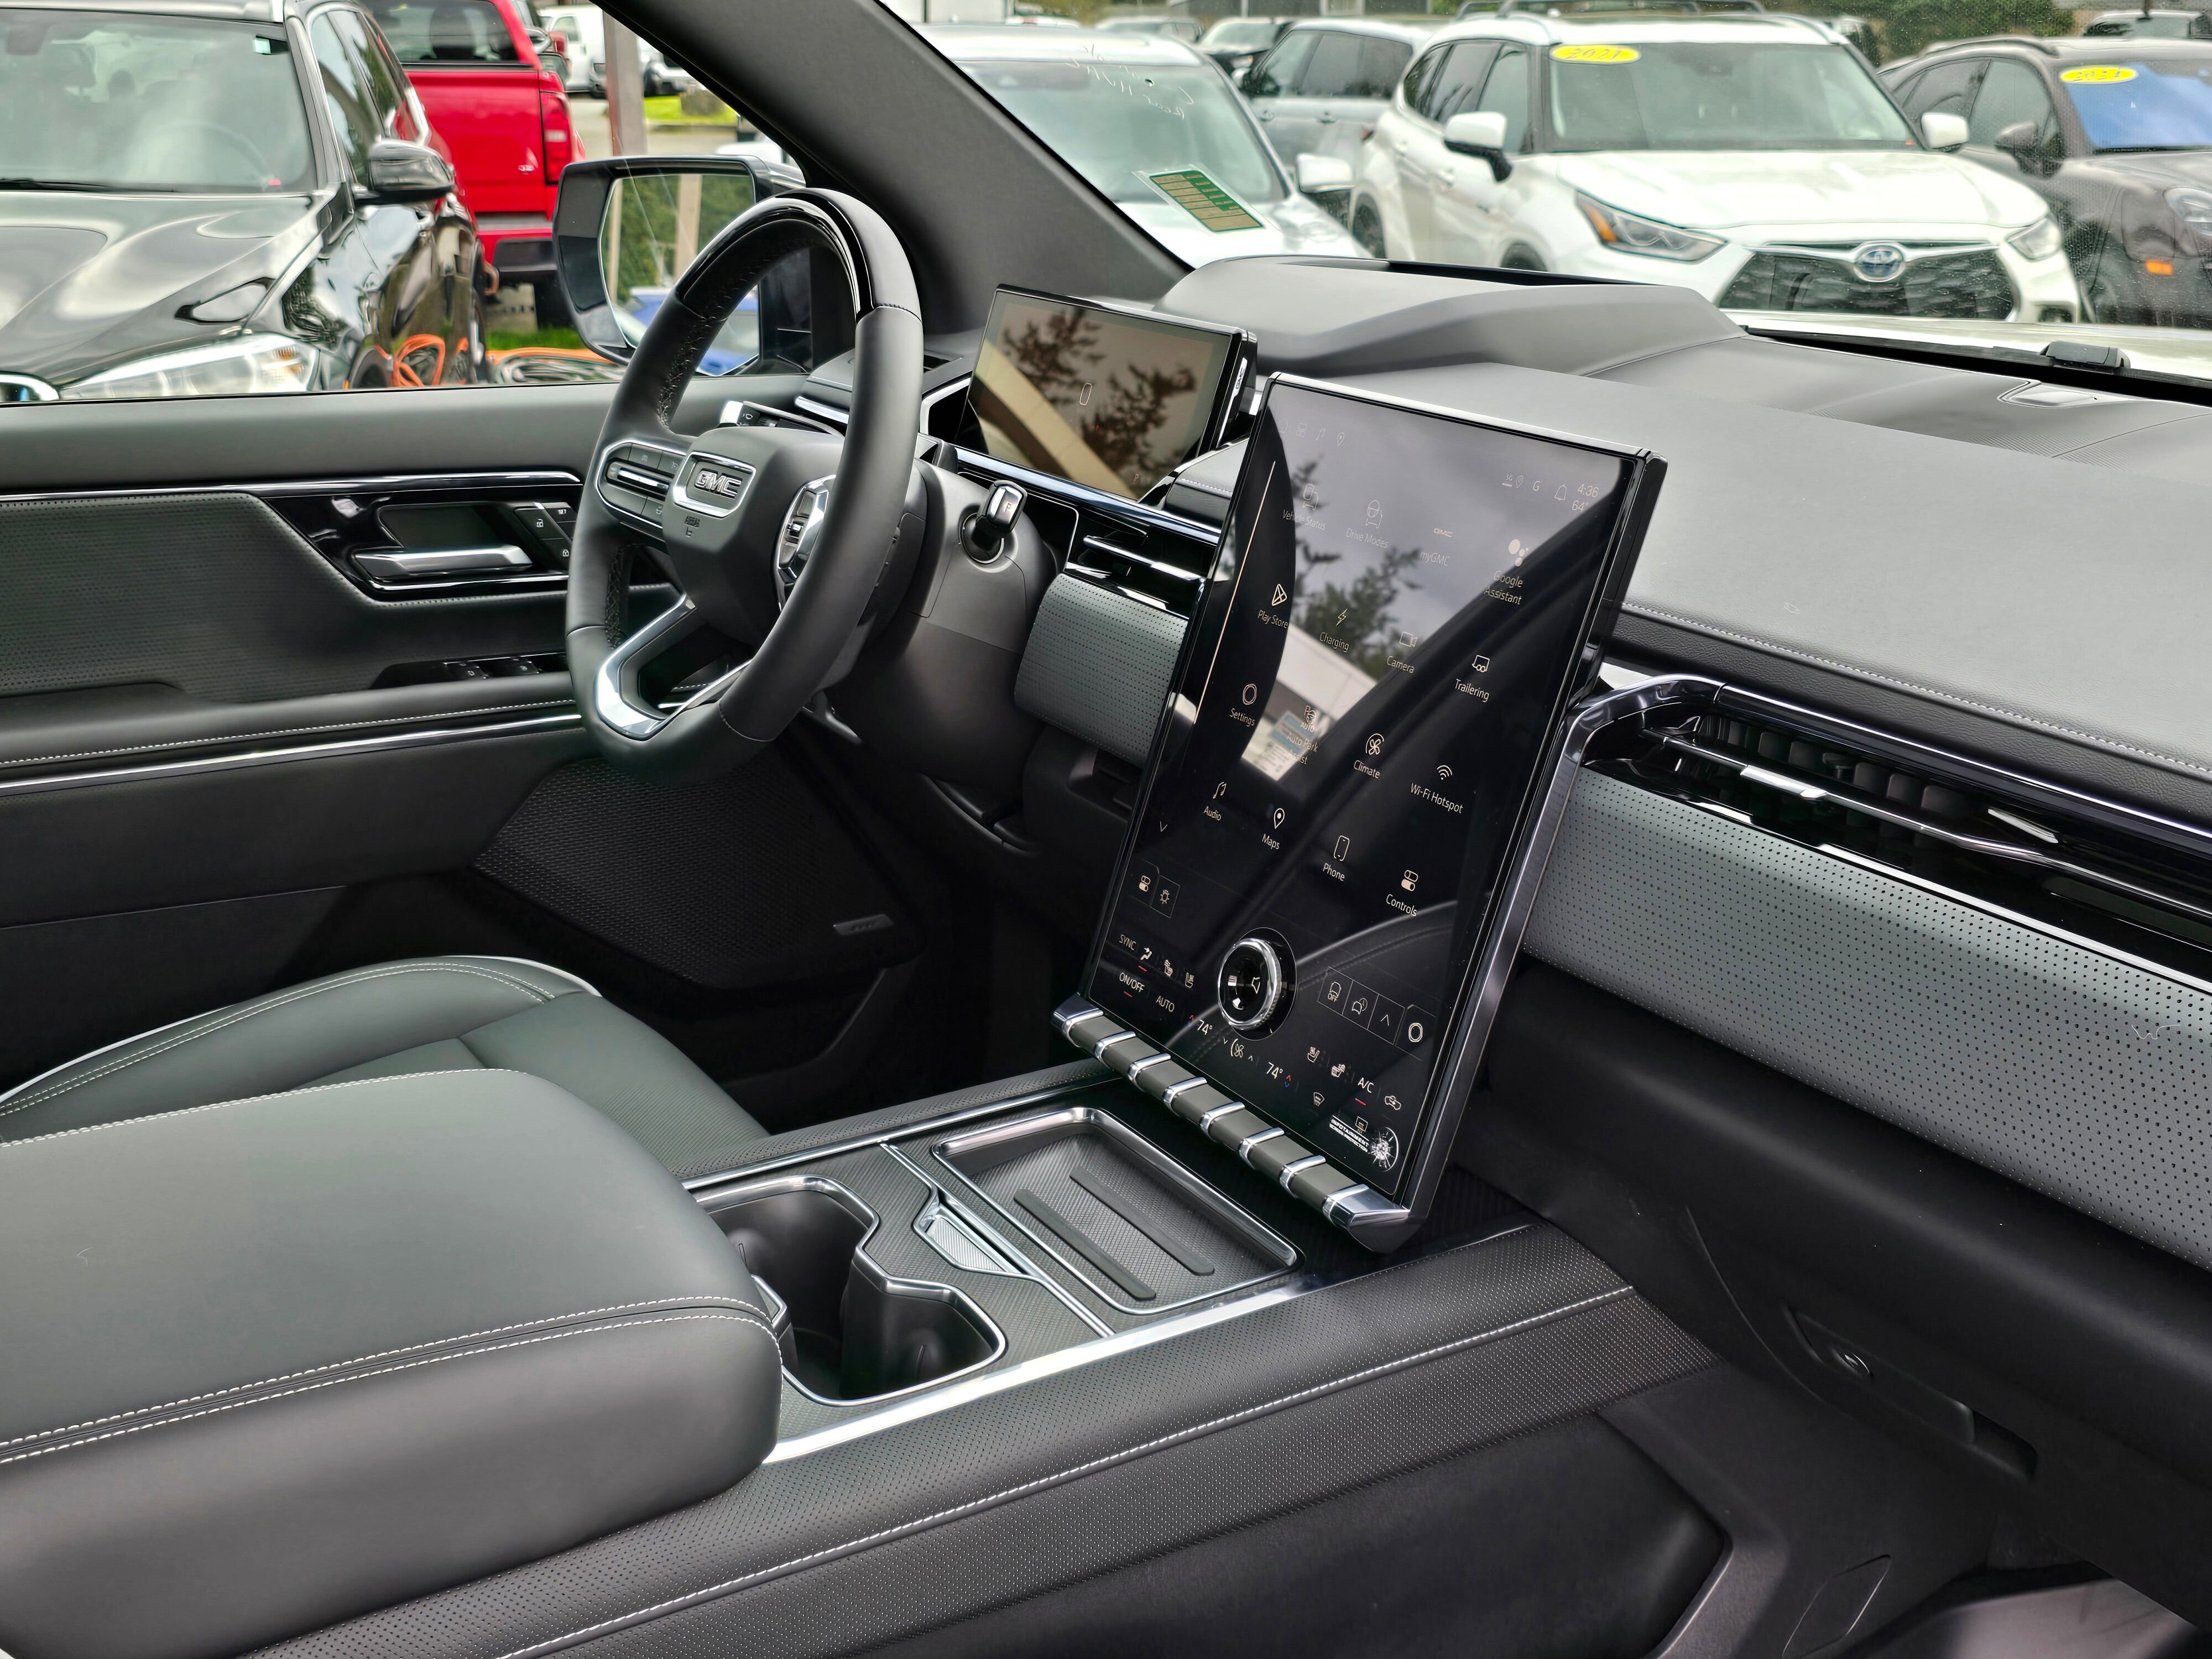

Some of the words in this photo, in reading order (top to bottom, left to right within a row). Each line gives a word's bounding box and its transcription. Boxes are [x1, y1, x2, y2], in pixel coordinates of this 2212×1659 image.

[695, 469, 742, 498] GMC
[1577, 484, 1599, 497] 4:36
[1004, 502, 1011, 513] P
[1283, 509, 1305, 524] Vehcle
[1305, 516, 1326, 530] Status
[1345, 528, 1364, 541] Drive
[1365, 534, 1389, 548] Modes
[1433, 528, 1453, 537] GMC
[1420, 552, 1450, 566] myGMC
[1494, 570, 1523, 588] Google
[1484, 586, 1522, 605] Assistant
[1258, 609, 1271, 624] Play
[1271, 614, 1288, 629] Store
[1319, 632, 1349, 653] Charging
[1387, 655, 1415, 674] Camera
[1455, 679, 1490, 703] Trailering
[1230, 708, 1255, 727] Settings
[1286, 733, 1302, 746] Auto
[1303, 739, 1318, 753] Park
[1288, 749, 1308, 765] ssst
[1354, 760, 1380, 779] Climate
[1411, 782, 1431, 800] Wi-Fi
[1431, 792, 1463, 813] Hotspot
[1203, 806, 1222, 821] Audio
[1262, 833, 1280, 849] Maps
[1323, 863, 1345, 881] Phone
[1386, 894, 1417, 917] Controls
[1119, 934, 1137, 951] SYNC
[1119, 972, 1145, 993] ON/OFF
[1156, 996, 1175, 1013] AUTO
[1197, 1019, 1213, 1035] 74°
[1266, 1062, 1283, 1079] 74°
[1358, 1077, 1374, 1093] A/C
